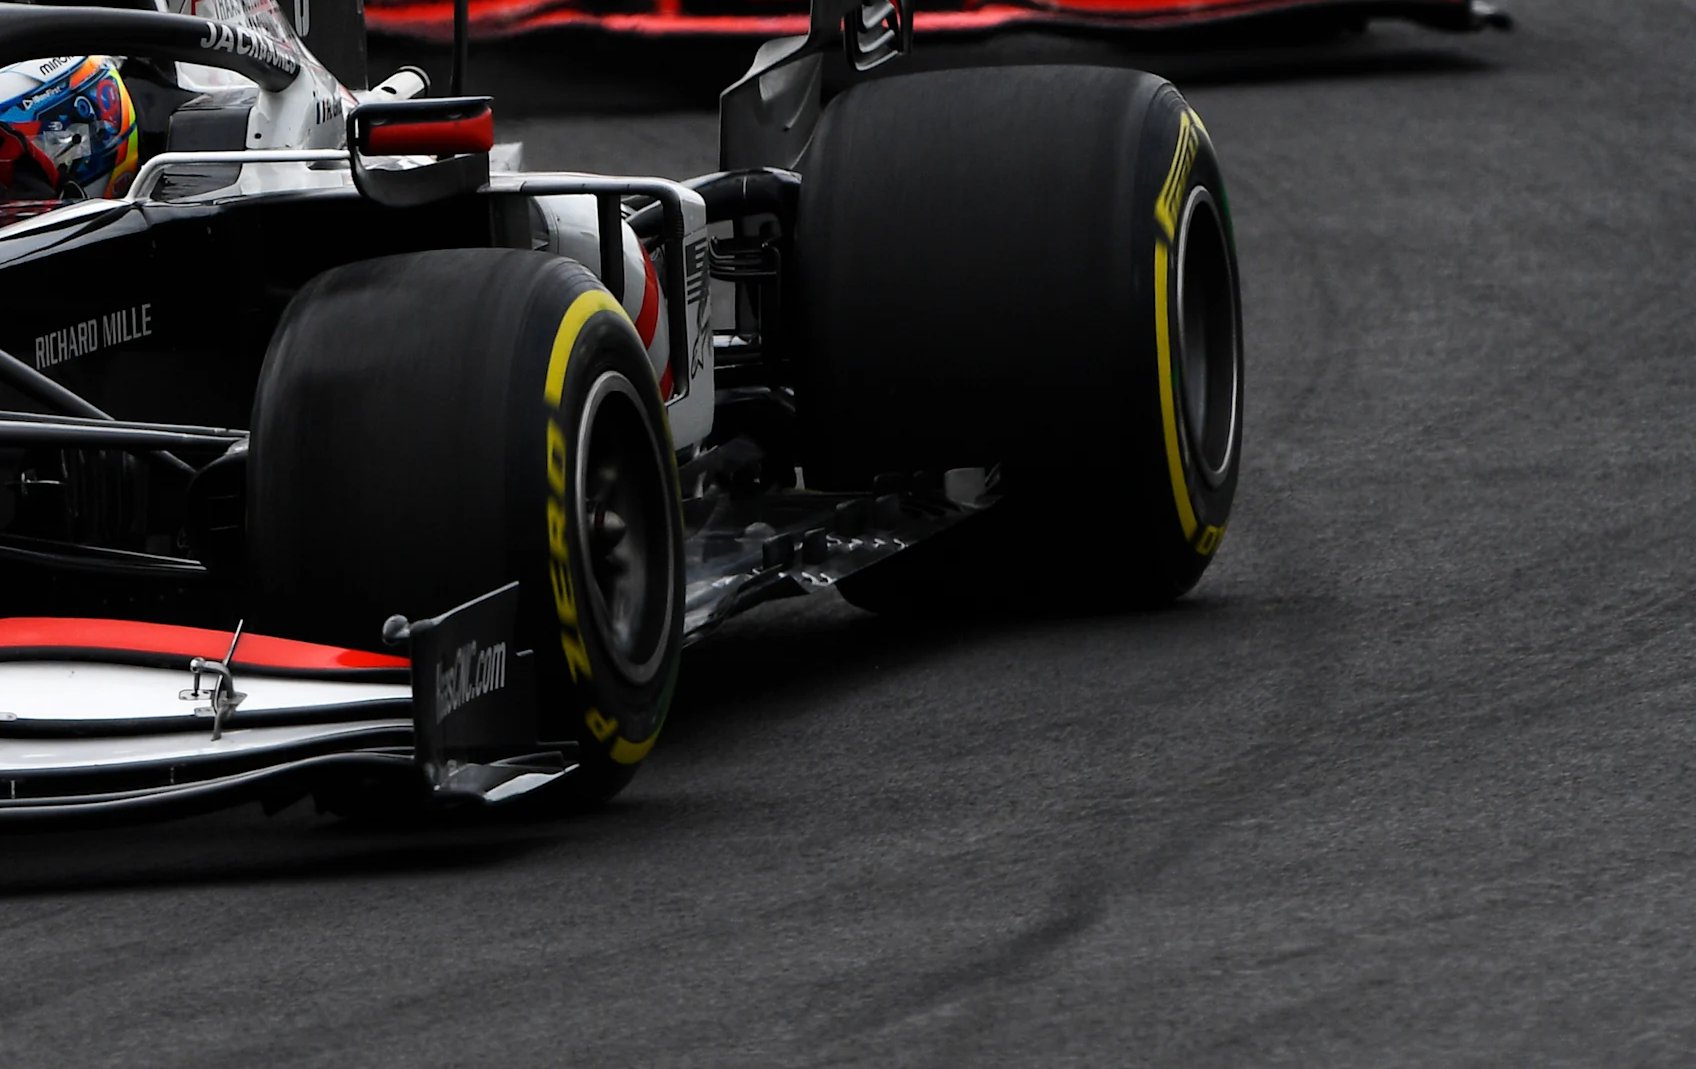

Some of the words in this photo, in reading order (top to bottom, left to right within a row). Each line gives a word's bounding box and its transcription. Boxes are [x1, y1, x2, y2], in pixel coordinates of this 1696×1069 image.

[35, 318, 98, 370] RICHARD
[103, 303, 152, 348] MILLE
[545, 417, 593, 685] ZERO
